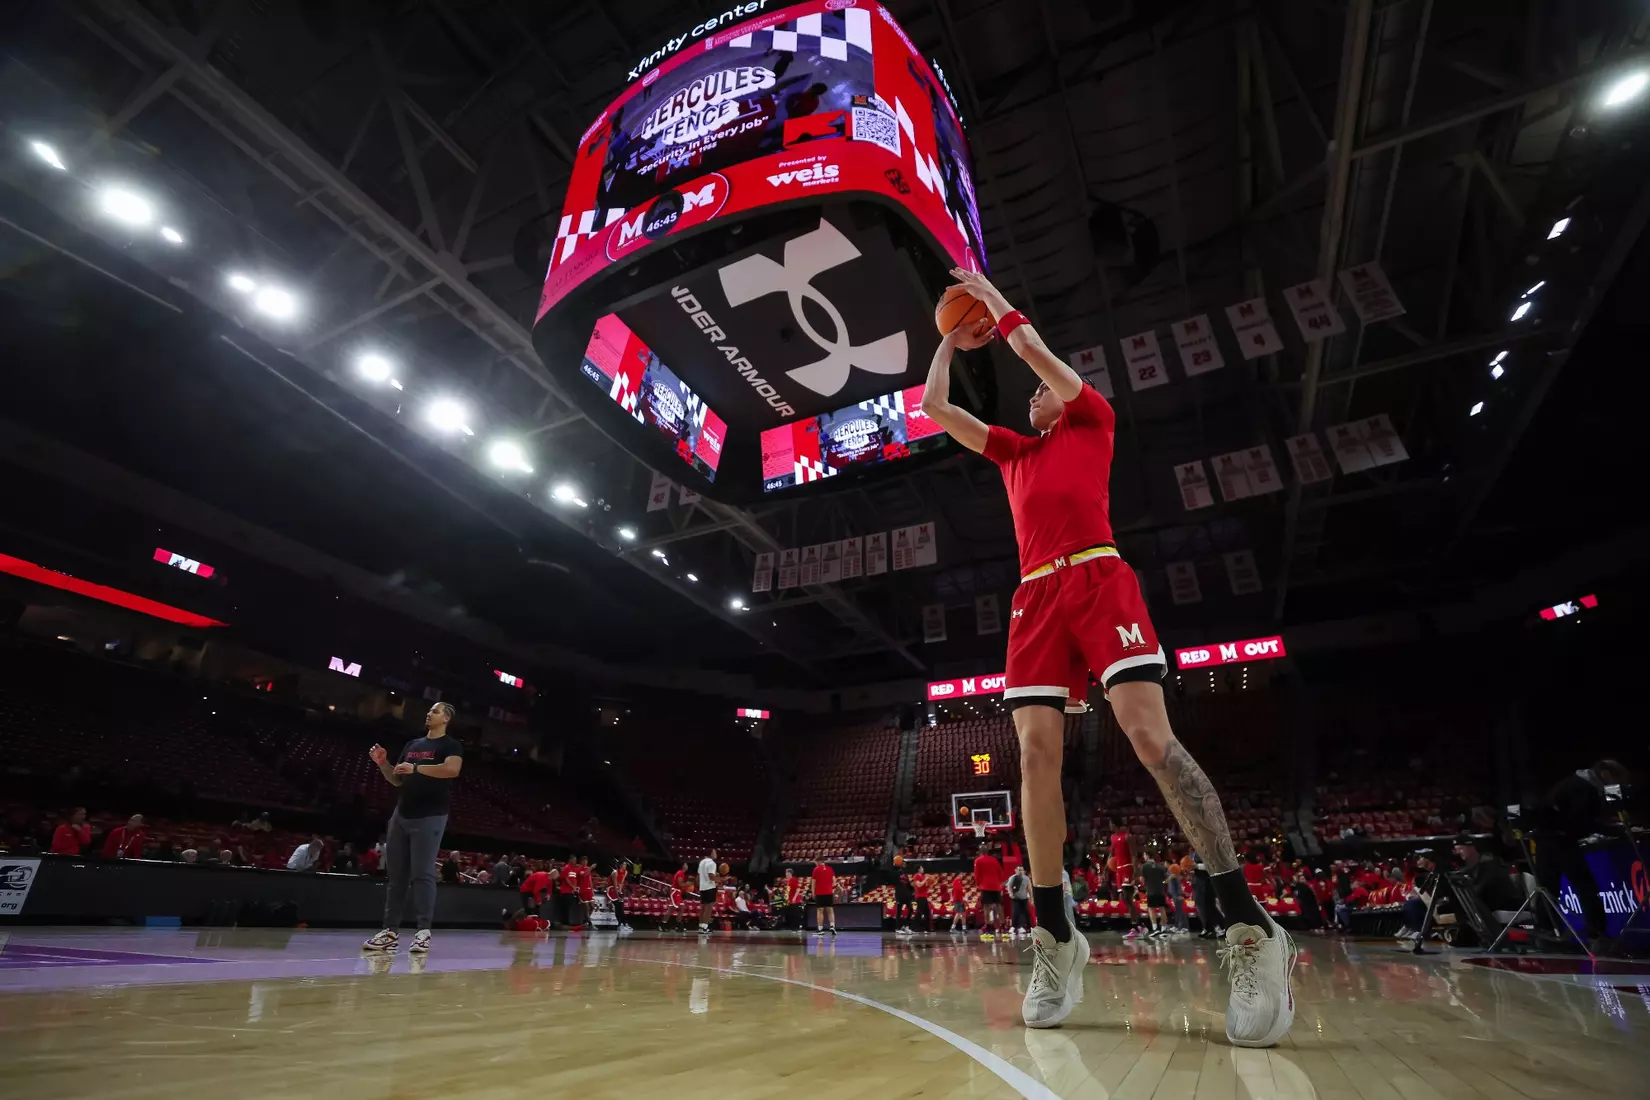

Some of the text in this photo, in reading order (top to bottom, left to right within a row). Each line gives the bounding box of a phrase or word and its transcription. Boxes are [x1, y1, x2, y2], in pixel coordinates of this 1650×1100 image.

[627, 33, 687, 82] xfinity
[692, 0, 767, 37] center
[641, 67, 773, 139] HERCULES
[662, 100, 737, 143] FENCE
[704, 126, 738, 143] Every
[778, 157, 816, 168] Presented
[766, 162, 839, 187] weis
[802, 176, 839, 187] markets
[682, 183, 716, 214] M
[646, 212, 678, 233] 46:45
[670, 285, 727, 343] NDER
[717, 346, 795, 417] ARMOUR
[1192, 349, 1212, 366] 23
[1138, 365, 1158, 381] 22
[1054, 556, 1067, 568] M
[1116, 623, 1146, 648] M
[1180, 640, 1279, 664] RED M OUT
[931, 683, 954, 696] RED
[962, 678, 976, 694] M
[974, 761, 990, 774] 30
